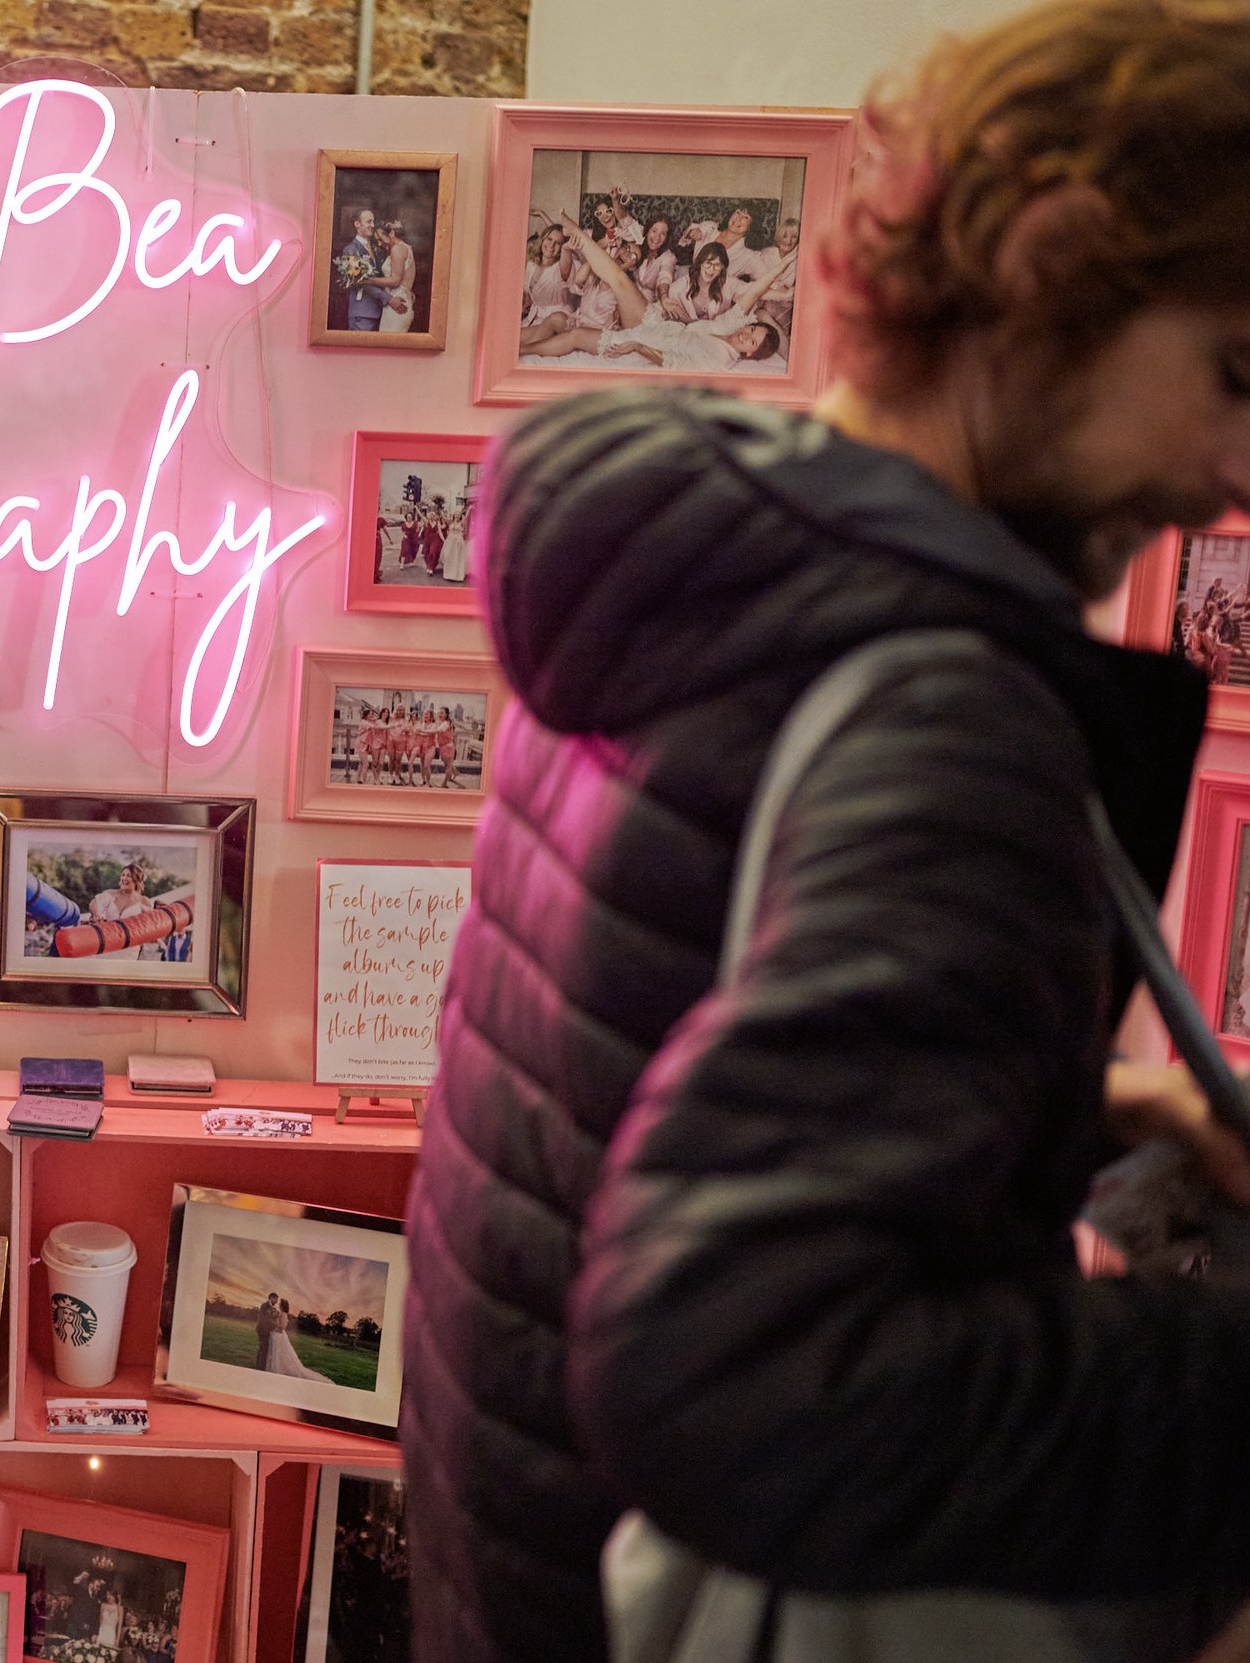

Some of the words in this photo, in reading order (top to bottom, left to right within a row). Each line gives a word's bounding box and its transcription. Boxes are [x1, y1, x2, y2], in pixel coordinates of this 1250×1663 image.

[325, 883, 366, 910] Feel
[371, 891, 403, 917] free
[401, 885, 424, 917] to
[427, 887, 466, 919] pick
[334, 915, 375, 947] the
[376, 918, 450, 951] sample
[343, 948, 415, 982] albums
[421, 959, 445, 984] up
[323, 980, 360, 1005] and
[363, 980, 406, 1009] have
[409, 993, 421, 1008] a
[326, 1011, 367, 1045] flick
